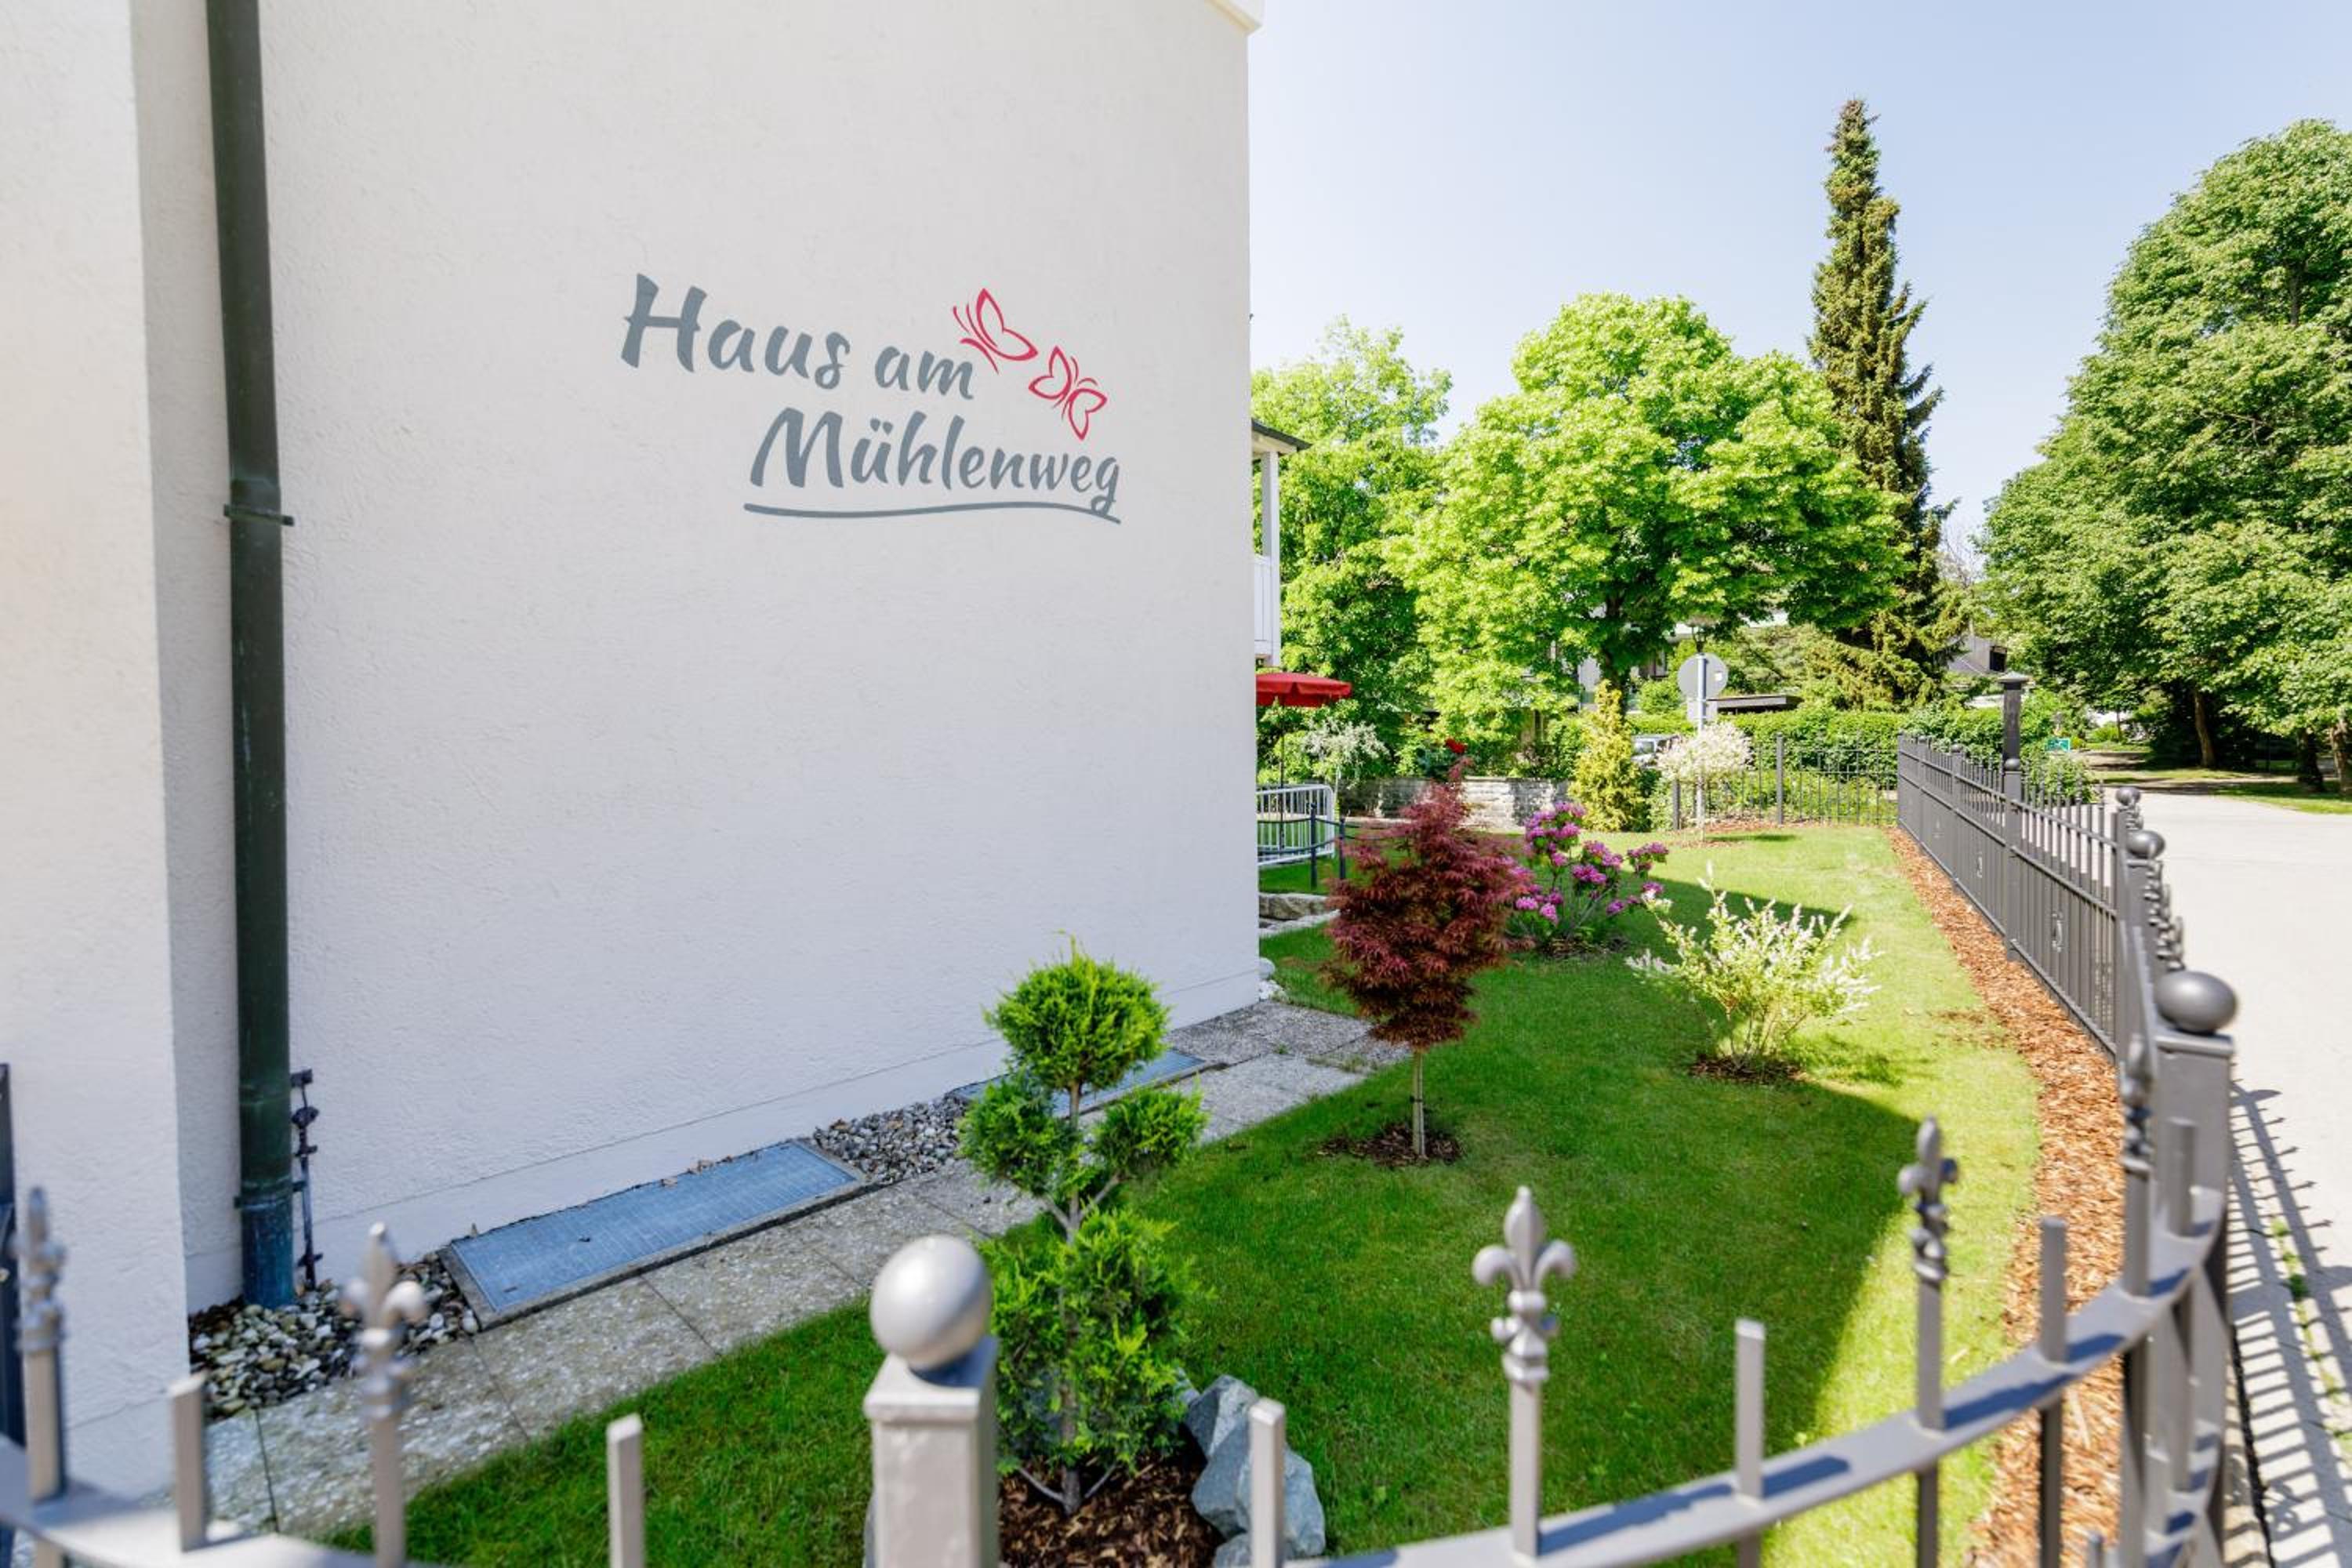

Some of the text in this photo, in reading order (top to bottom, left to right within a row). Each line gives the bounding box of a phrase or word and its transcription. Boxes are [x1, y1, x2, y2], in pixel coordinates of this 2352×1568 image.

[620, 273, 974, 400] Haus am
[750, 407, 1120, 515] Mühlenweg
